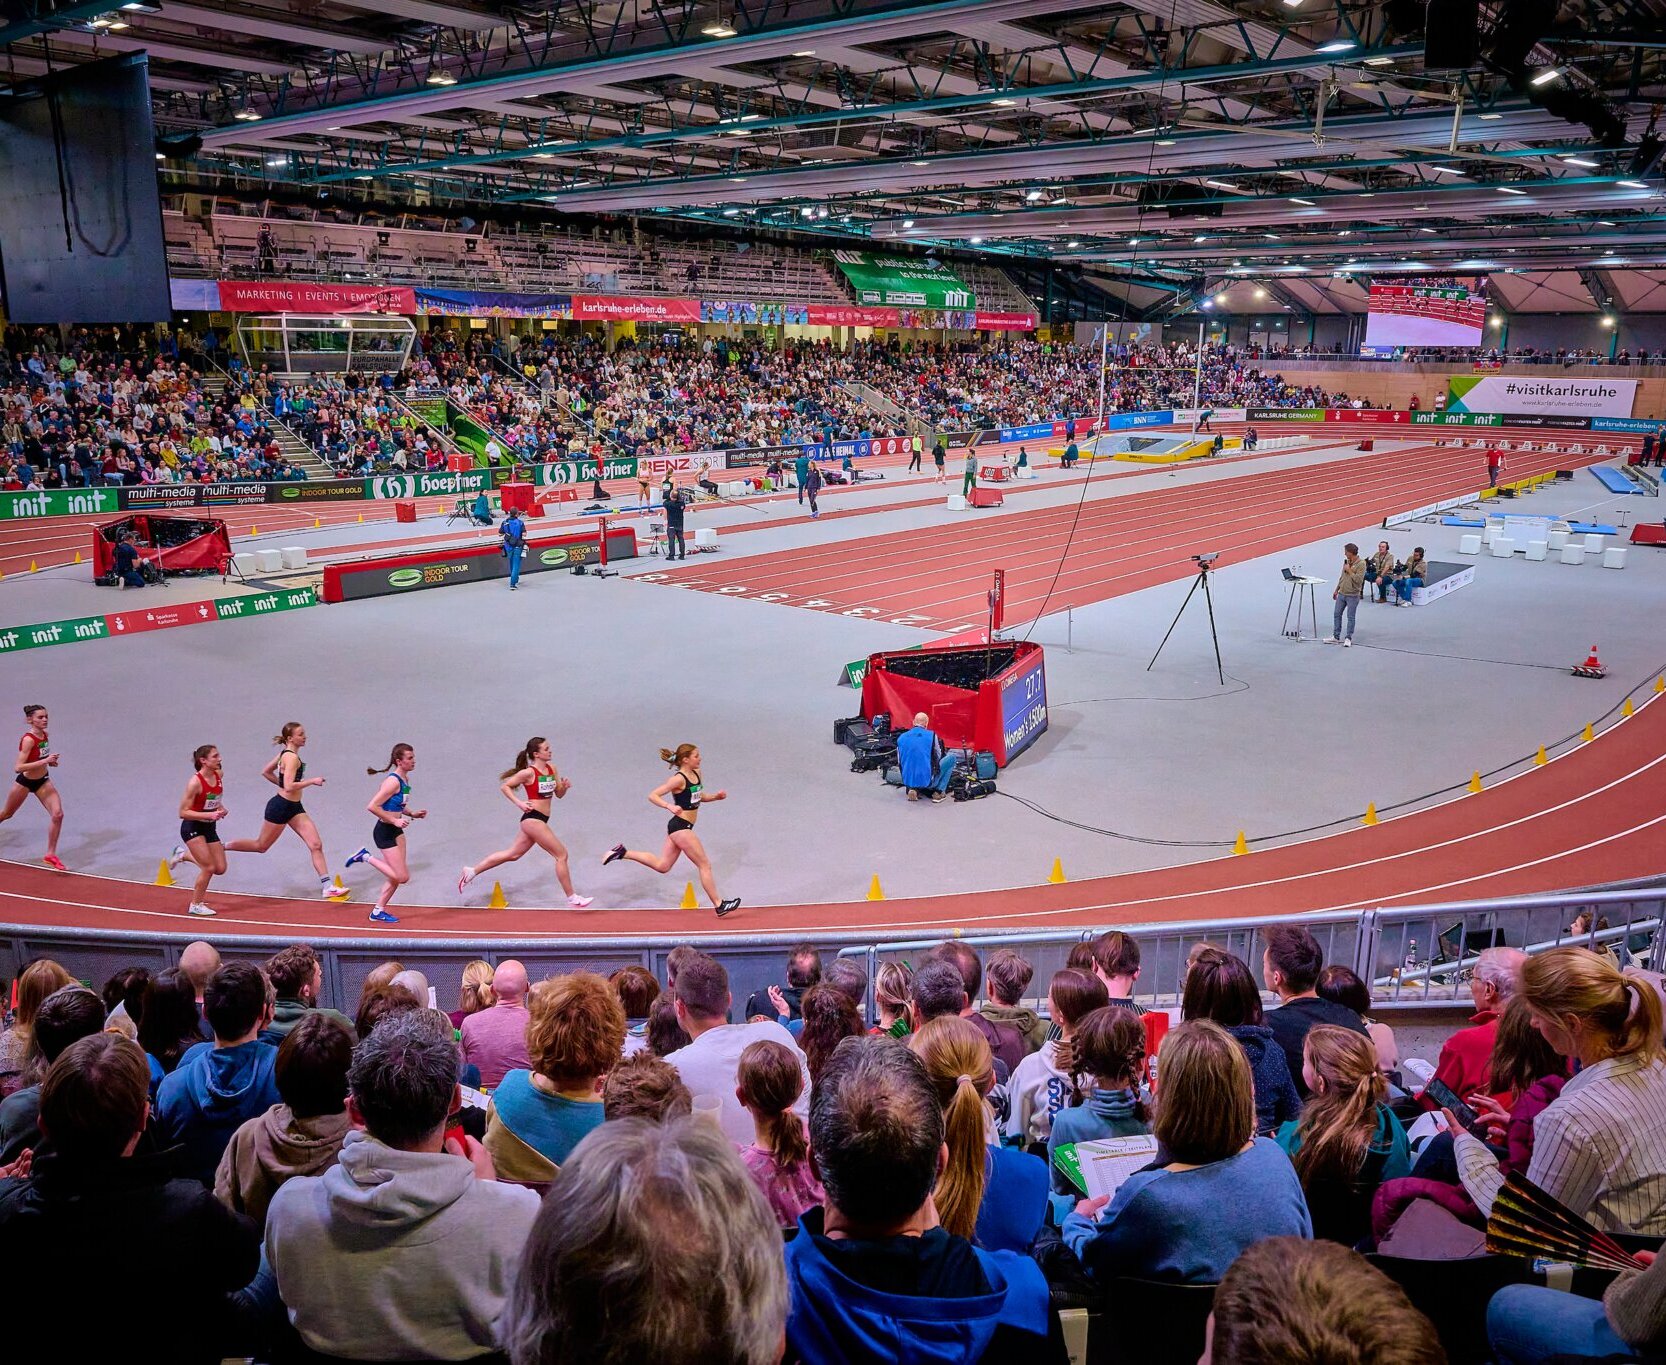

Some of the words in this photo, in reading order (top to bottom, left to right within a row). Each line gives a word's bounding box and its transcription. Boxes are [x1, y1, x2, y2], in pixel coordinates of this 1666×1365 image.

[874, 259, 907, 268] public
[237, 290, 293, 300] MARKETING
[306, 292, 339, 301] EVENTS
[582, 301, 667, 315] karlsruhe-erleben.de
[1506, 383, 1618, 398] #visitkarlsruhe
[1522, 399, 1603, 408] www.karlsruhe-erleben.de
[1133, 416, 1147, 425] BNN
[1416, 413, 1438, 423] init
[1445, 413, 1467, 424] init
[1474, 413, 1496, 425] init
[730, 451, 765, 460] multi-media
[768, 448, 800, 458] multi-media
[581, 461, 633, 480] hopfner
[128, 486, 196, 499] multi-media
[202, 484, 267, 496] multi-media
[301, 489, 327, 497] INDOOR
[12, 492, 53, 517] init
[68, 490, 107, 514] init
[165, 499, 195, 508] systeme
[237, 496, 265, 504] systeme
[569, 547, 591, 556] INDOOR
[569, 553, 586, 562] GOLD
[424, 567, 451, 576] INDOOR
[451, 564, 469, 573] TOUR
[424, 574, 445, 584] GOLD
[219, 600, 245, 617] init
[254, 594, 279, 612] init
[288, 590, 312, 606] init
[31, 625, 63, 644] init
[74, 619, 105, 638] init
[1025, 668, 1042, 700] 27.7
[1004, 716, 1029, 751] Women's
[1028, 703, 1047, 731] 1500m
